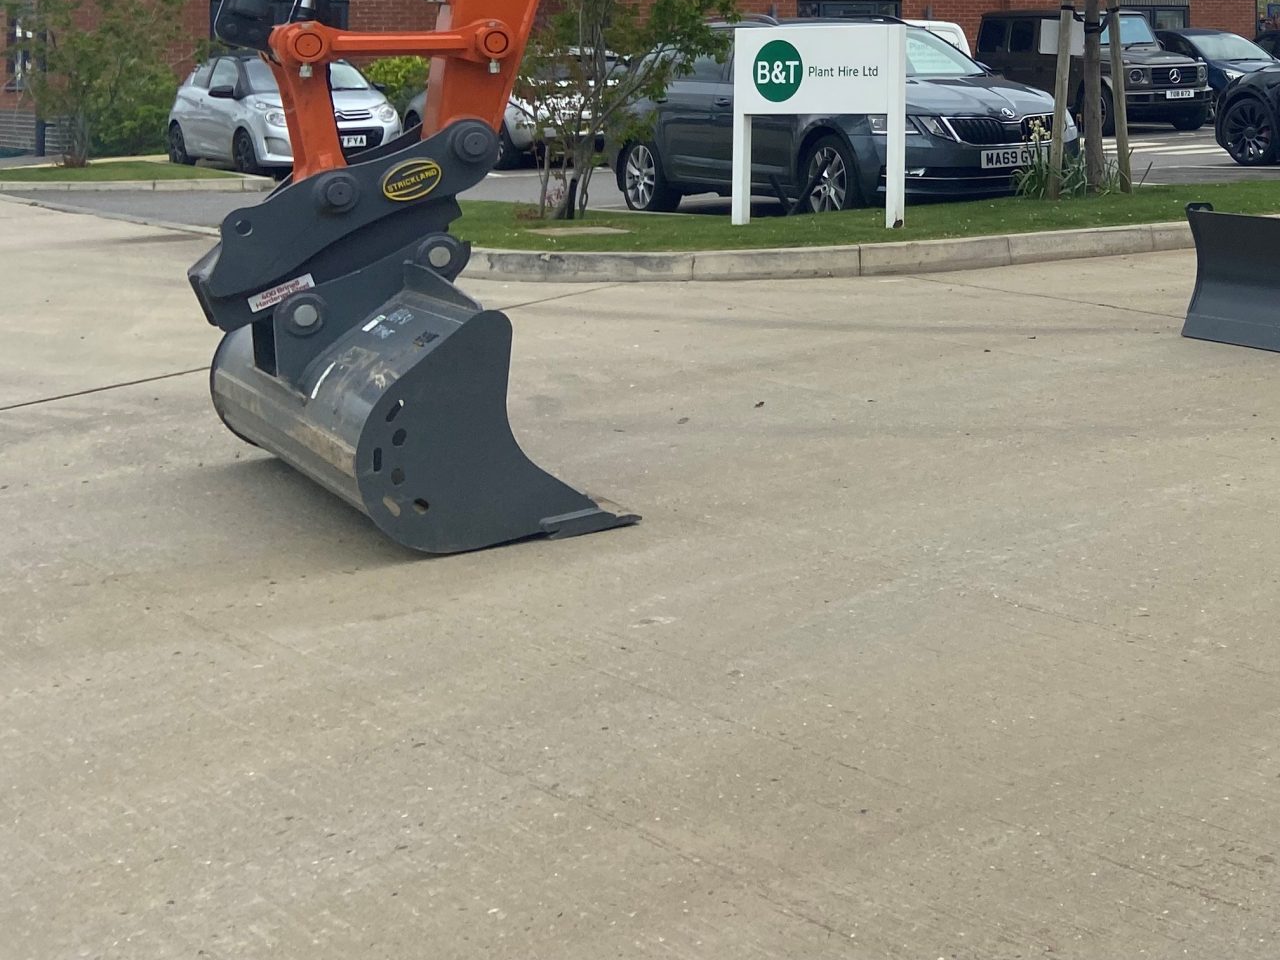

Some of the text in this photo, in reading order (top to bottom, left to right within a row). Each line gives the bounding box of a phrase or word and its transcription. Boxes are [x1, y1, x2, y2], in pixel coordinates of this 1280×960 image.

[757, 60, 879, 84] B&T Plant Hire Ltd
[986, 151, 1017, 166] MA69
[387, 168, 437, 192] STRICKLAND
